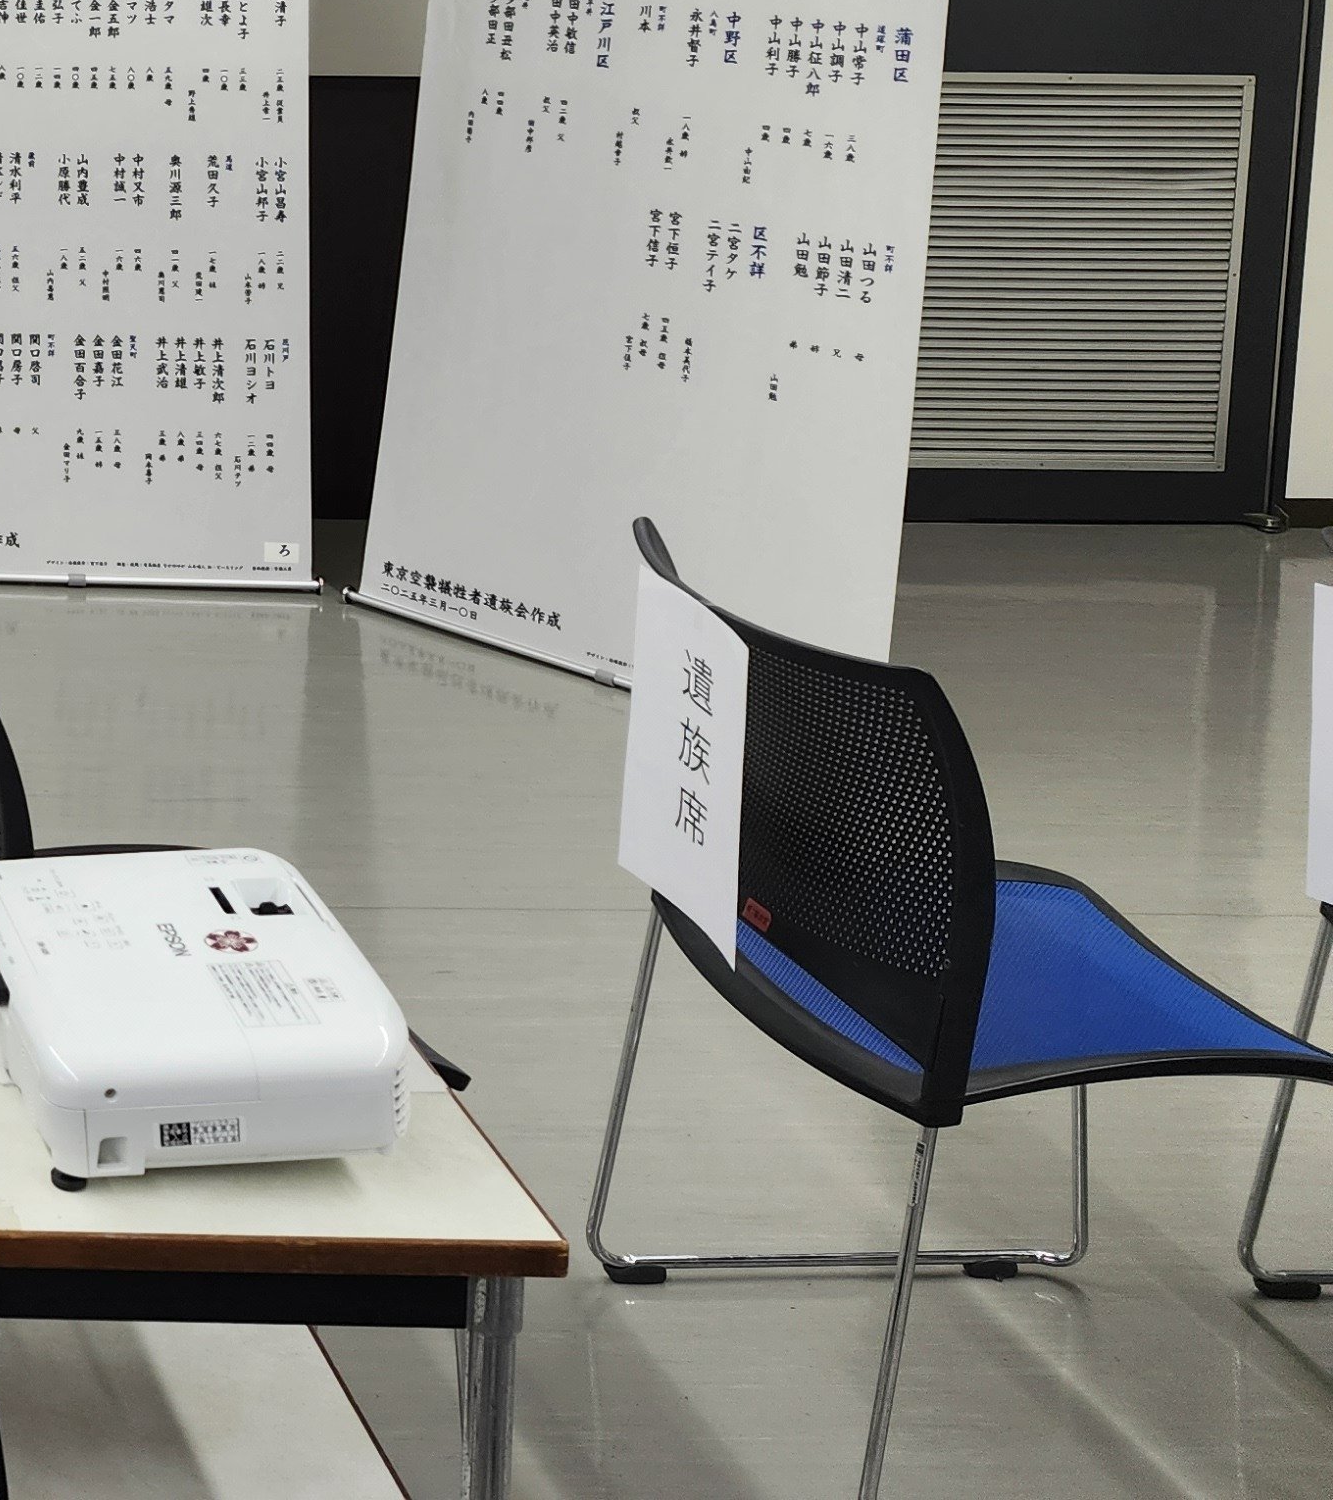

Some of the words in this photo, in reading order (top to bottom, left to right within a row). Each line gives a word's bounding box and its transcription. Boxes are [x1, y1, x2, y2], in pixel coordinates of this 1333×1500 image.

[563, 0, 581, 55] 田中敏信
[596, 1, 616, 69] 江戸川区
[637, 4, 653, 34] 川本
[723, 10, 742, 65] 中野区
[764, 14, 783, 77] 中山利子
[804, 18, 826, 98] 中山征八郎
[849, 22, 870, 86] 中山常子
[893, 26, 915, 84] 蒲田区
[131, 152, 146, 208] 中村又市
[206, 154, 221, 209] 荒田久子
[644, 208, 664, 268] 宮下信子
[701, 219, 722, 293] 二宮テイ子
[748, 225, 768, 280] 区不詳
[834, 238, 855, 299] 山田清二
[859, 242, 877, 304] 山田つる
[109, 334, 124, 388] 金田花江
[210, 337, 226, 405] 井上清次郎
[244, 338, 258, 405] 石川ヨシオ
[380, 559, 563, 632] 東京空襲犠牲者遺族会作成
[674, 648, 715, 848] 遺族席
[155, 922, 192, 957] EPSON
